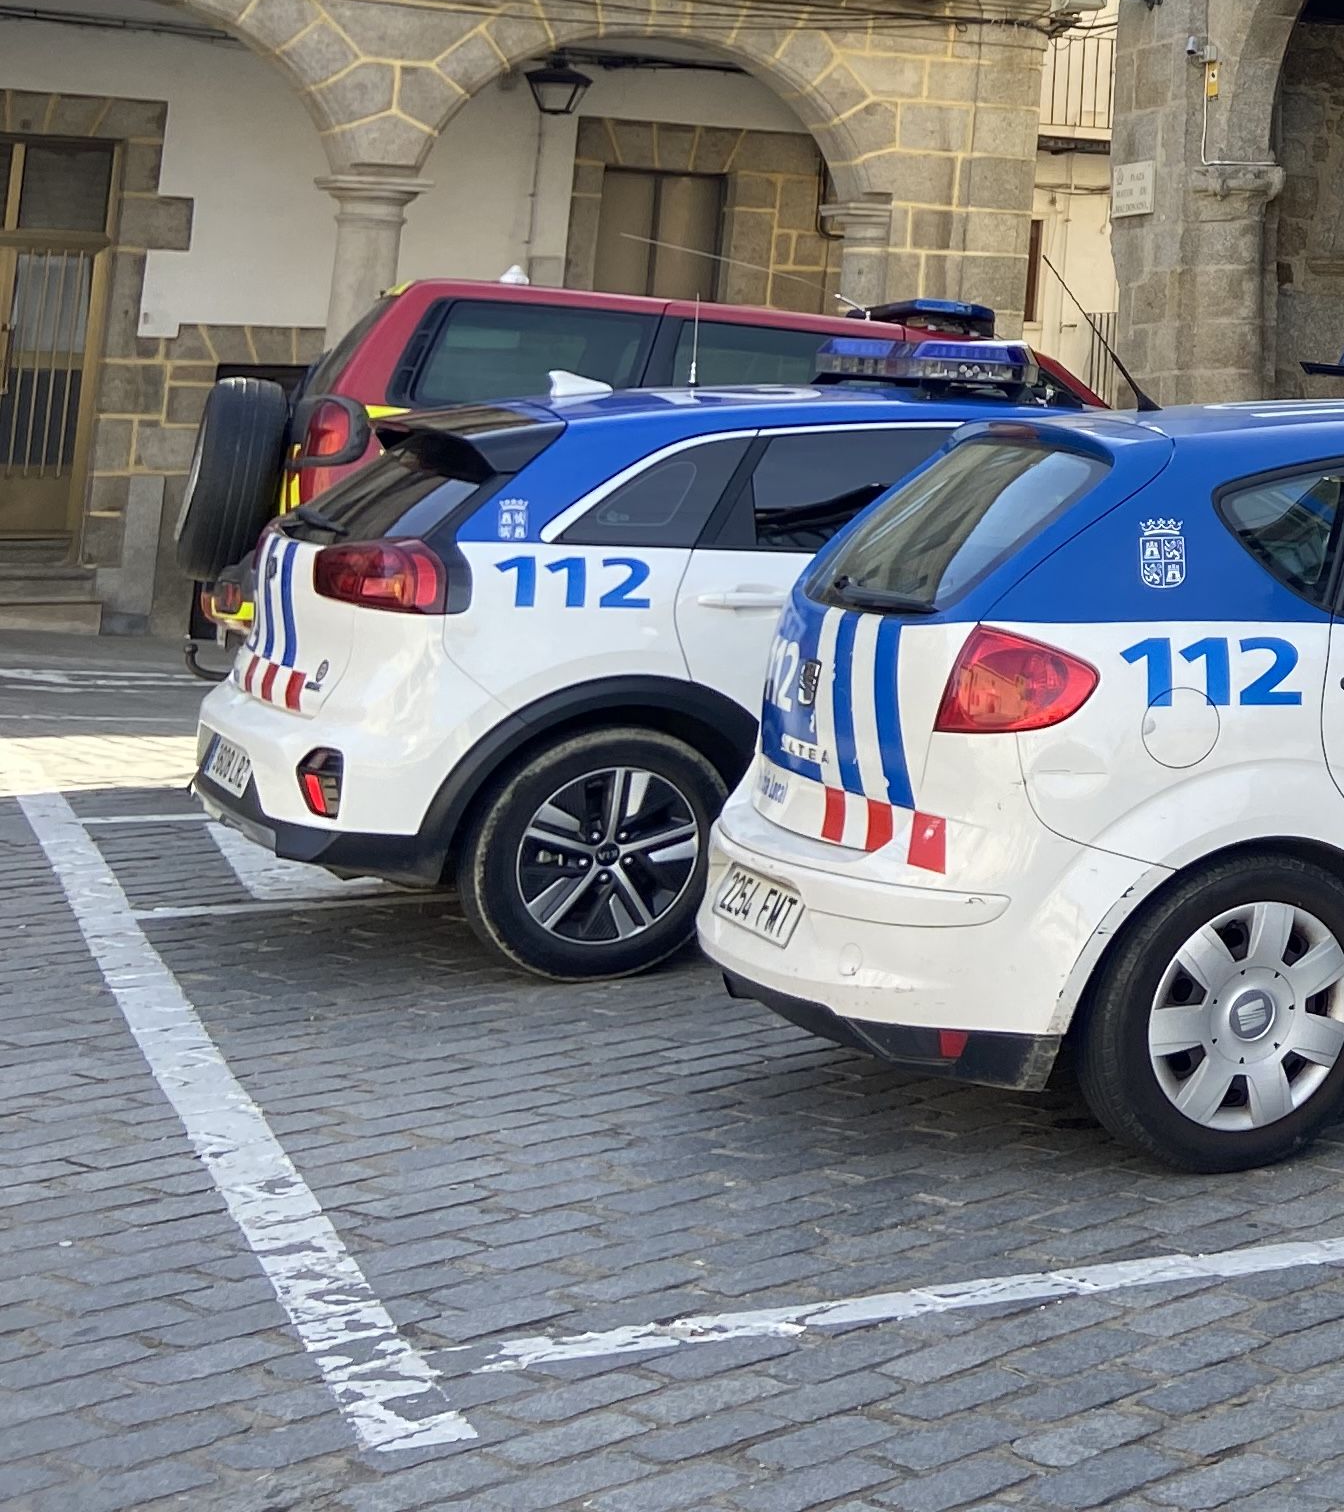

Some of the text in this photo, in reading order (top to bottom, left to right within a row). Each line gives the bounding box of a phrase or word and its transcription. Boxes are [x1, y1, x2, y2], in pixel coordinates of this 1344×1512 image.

[494, 555, 651, 609] 112
[1119, 636, 1303, 706] 112
[781, 734, 830, 764] LTEA
[720, 872, 798, 937] 2254 FMT
